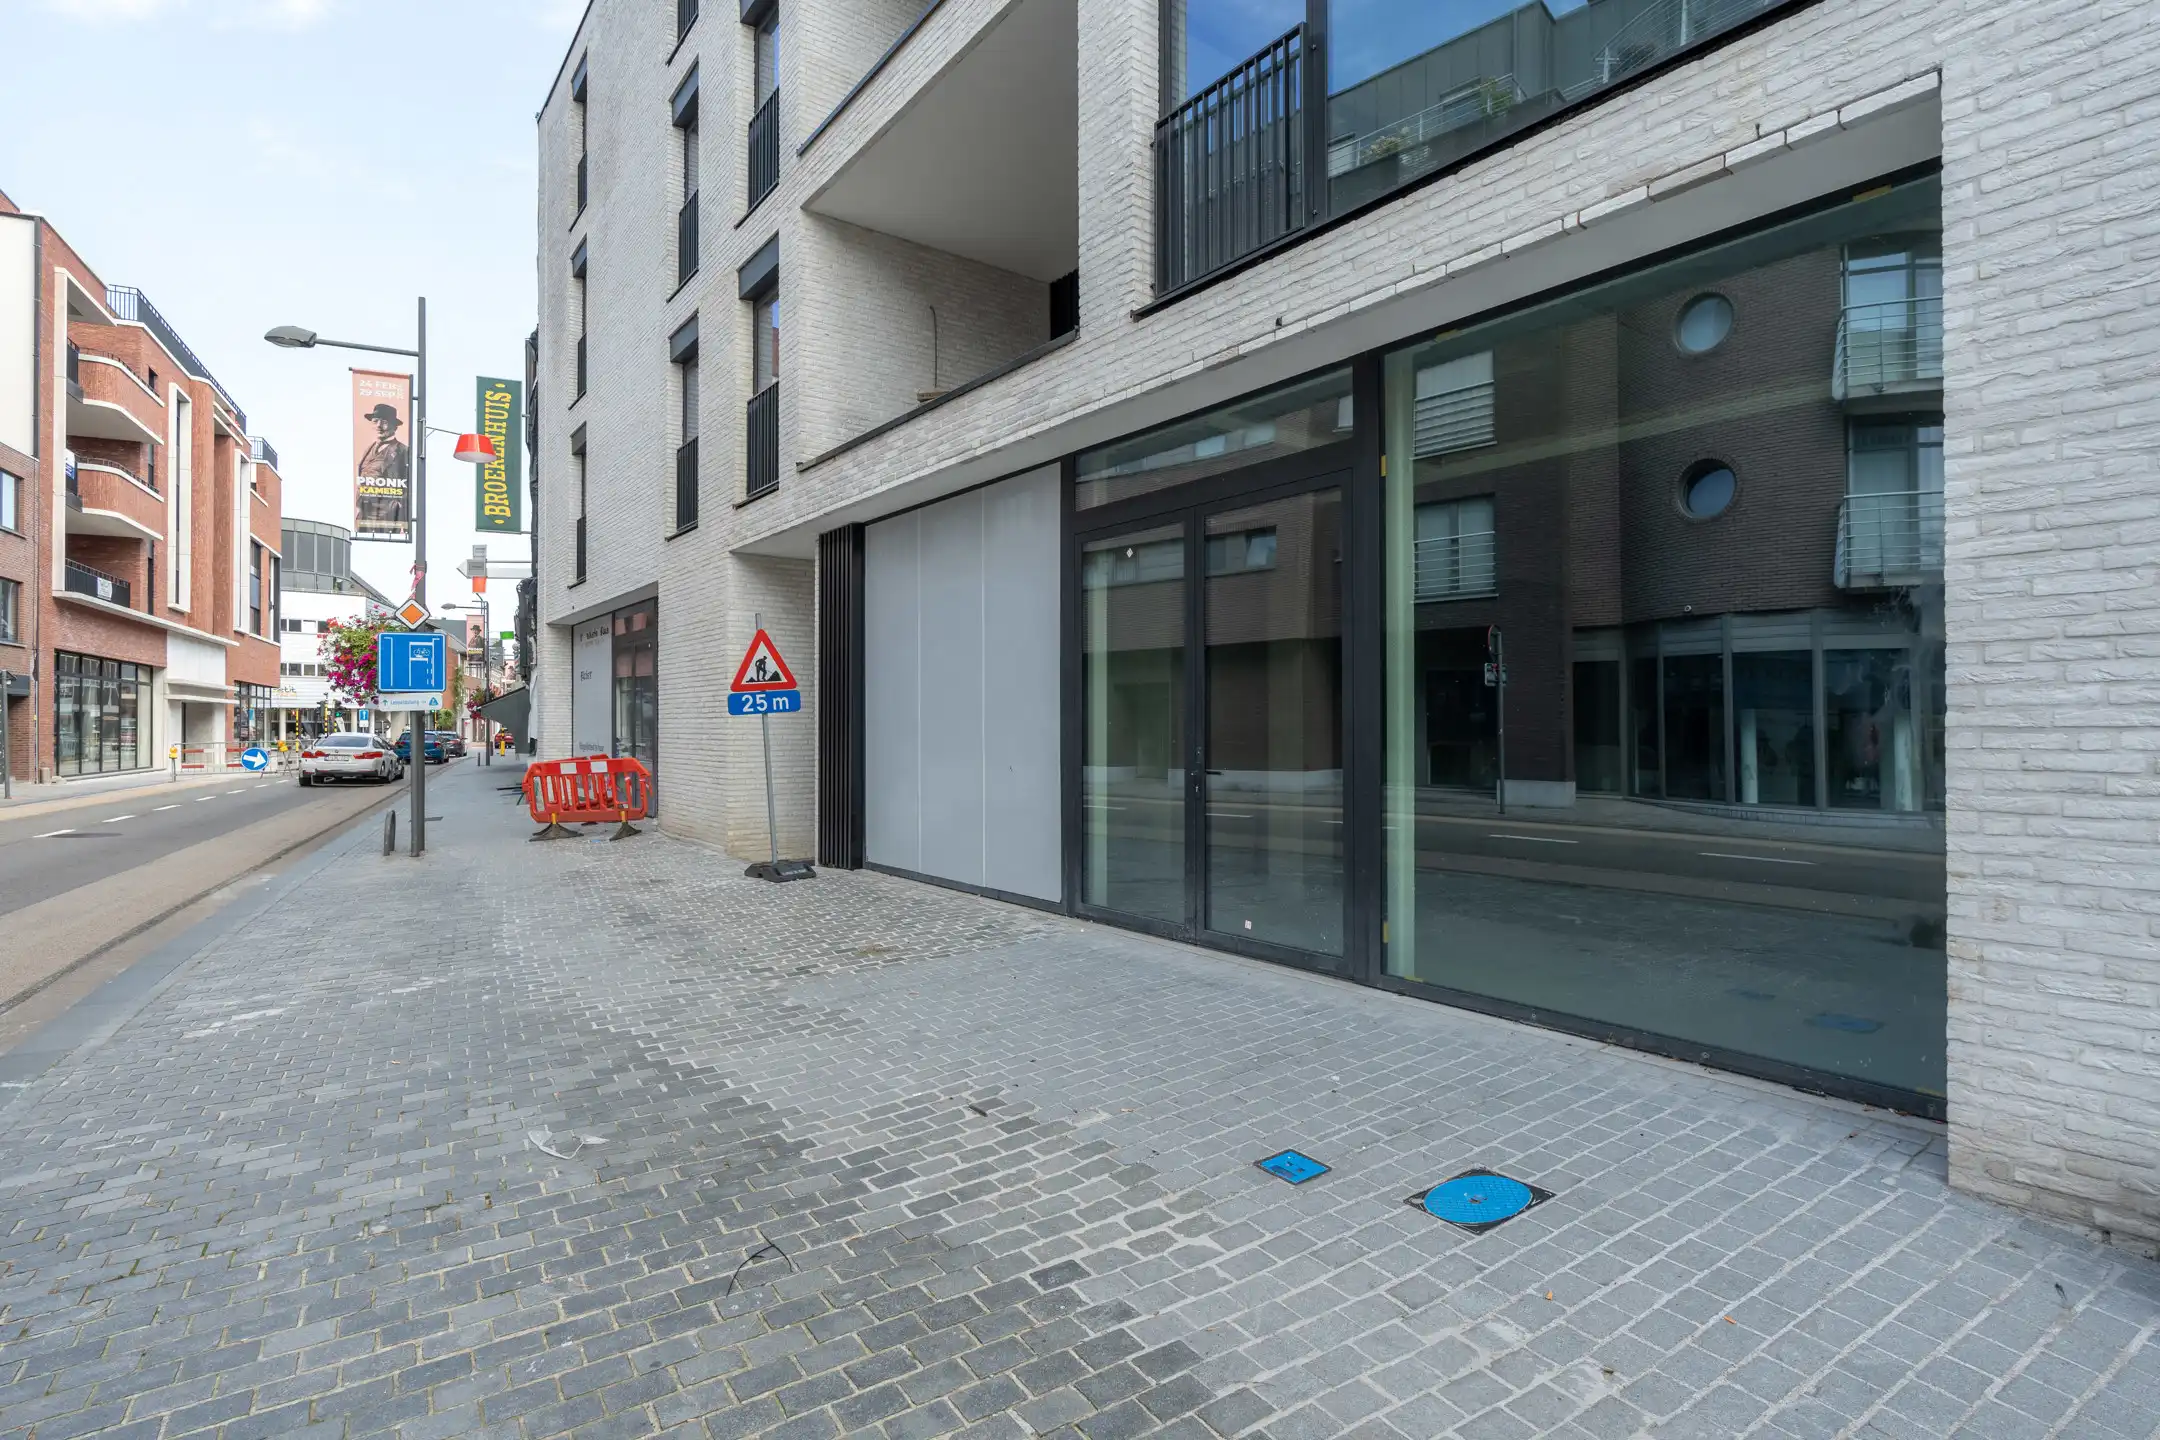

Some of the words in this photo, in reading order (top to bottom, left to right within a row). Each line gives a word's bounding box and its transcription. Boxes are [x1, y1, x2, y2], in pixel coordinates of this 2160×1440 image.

[356, 476, 408, 489] PRONK
[359, 486, 403, 496] KAMERS
[741, 694, 768, 712] 25
[772, 696, 789, 710] m
